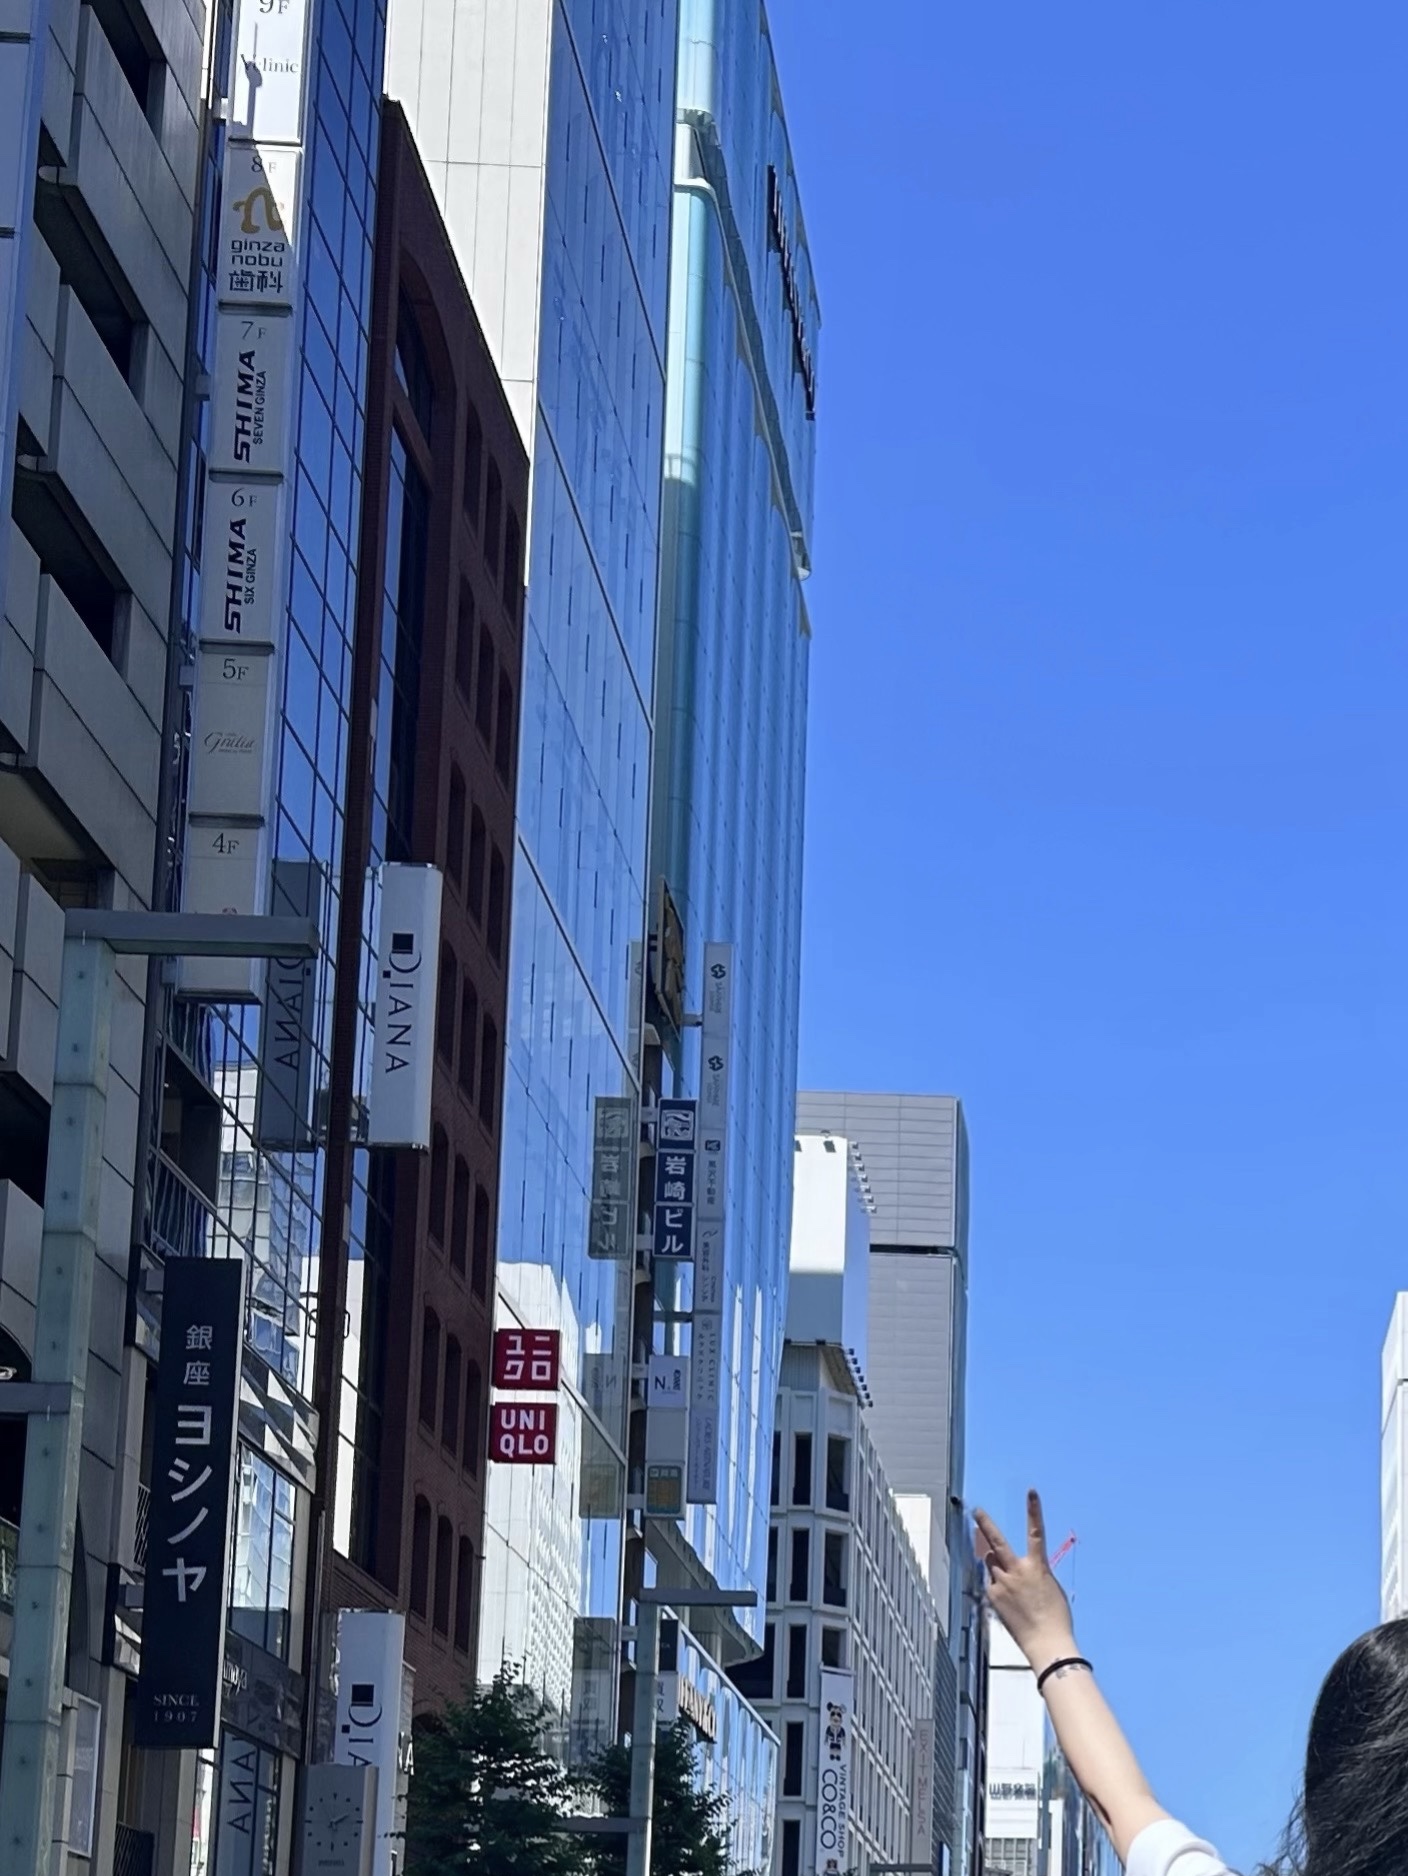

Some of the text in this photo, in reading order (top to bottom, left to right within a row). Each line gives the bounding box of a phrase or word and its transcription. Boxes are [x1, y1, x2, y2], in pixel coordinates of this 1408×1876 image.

[231, 238, 285, 253] ginza
[231, 254, 283, 267] nobu
[228, 269, 284, 293] 歯科
[234, 350, 256, 463] SHIMA
[253, 370, 267, 445] SEVEN GINZA
[224, 518, 247, 634] SHIMA
[244, 548, 257, 605] SIX GINZA
[222, 658, 249, 680] 5F
[212, 832, 240, 854] 4F
[383, 933, 422, 1074] DIANA
[661, 1155, 687, 1254] 岩崎ビル
[505, 1335, 552, 1356] ユニ
[503, 1360, 551, 1381] クロ
[501, 1409, 545, 1431] UNI
[499, 1433, 549, 1459] QLO
[153, 1709, 198, 1723] 1907
[820, 1768, 838, 1850] CO&CO
[837, 1763, 847, 1858] VINTAGE SHOP
